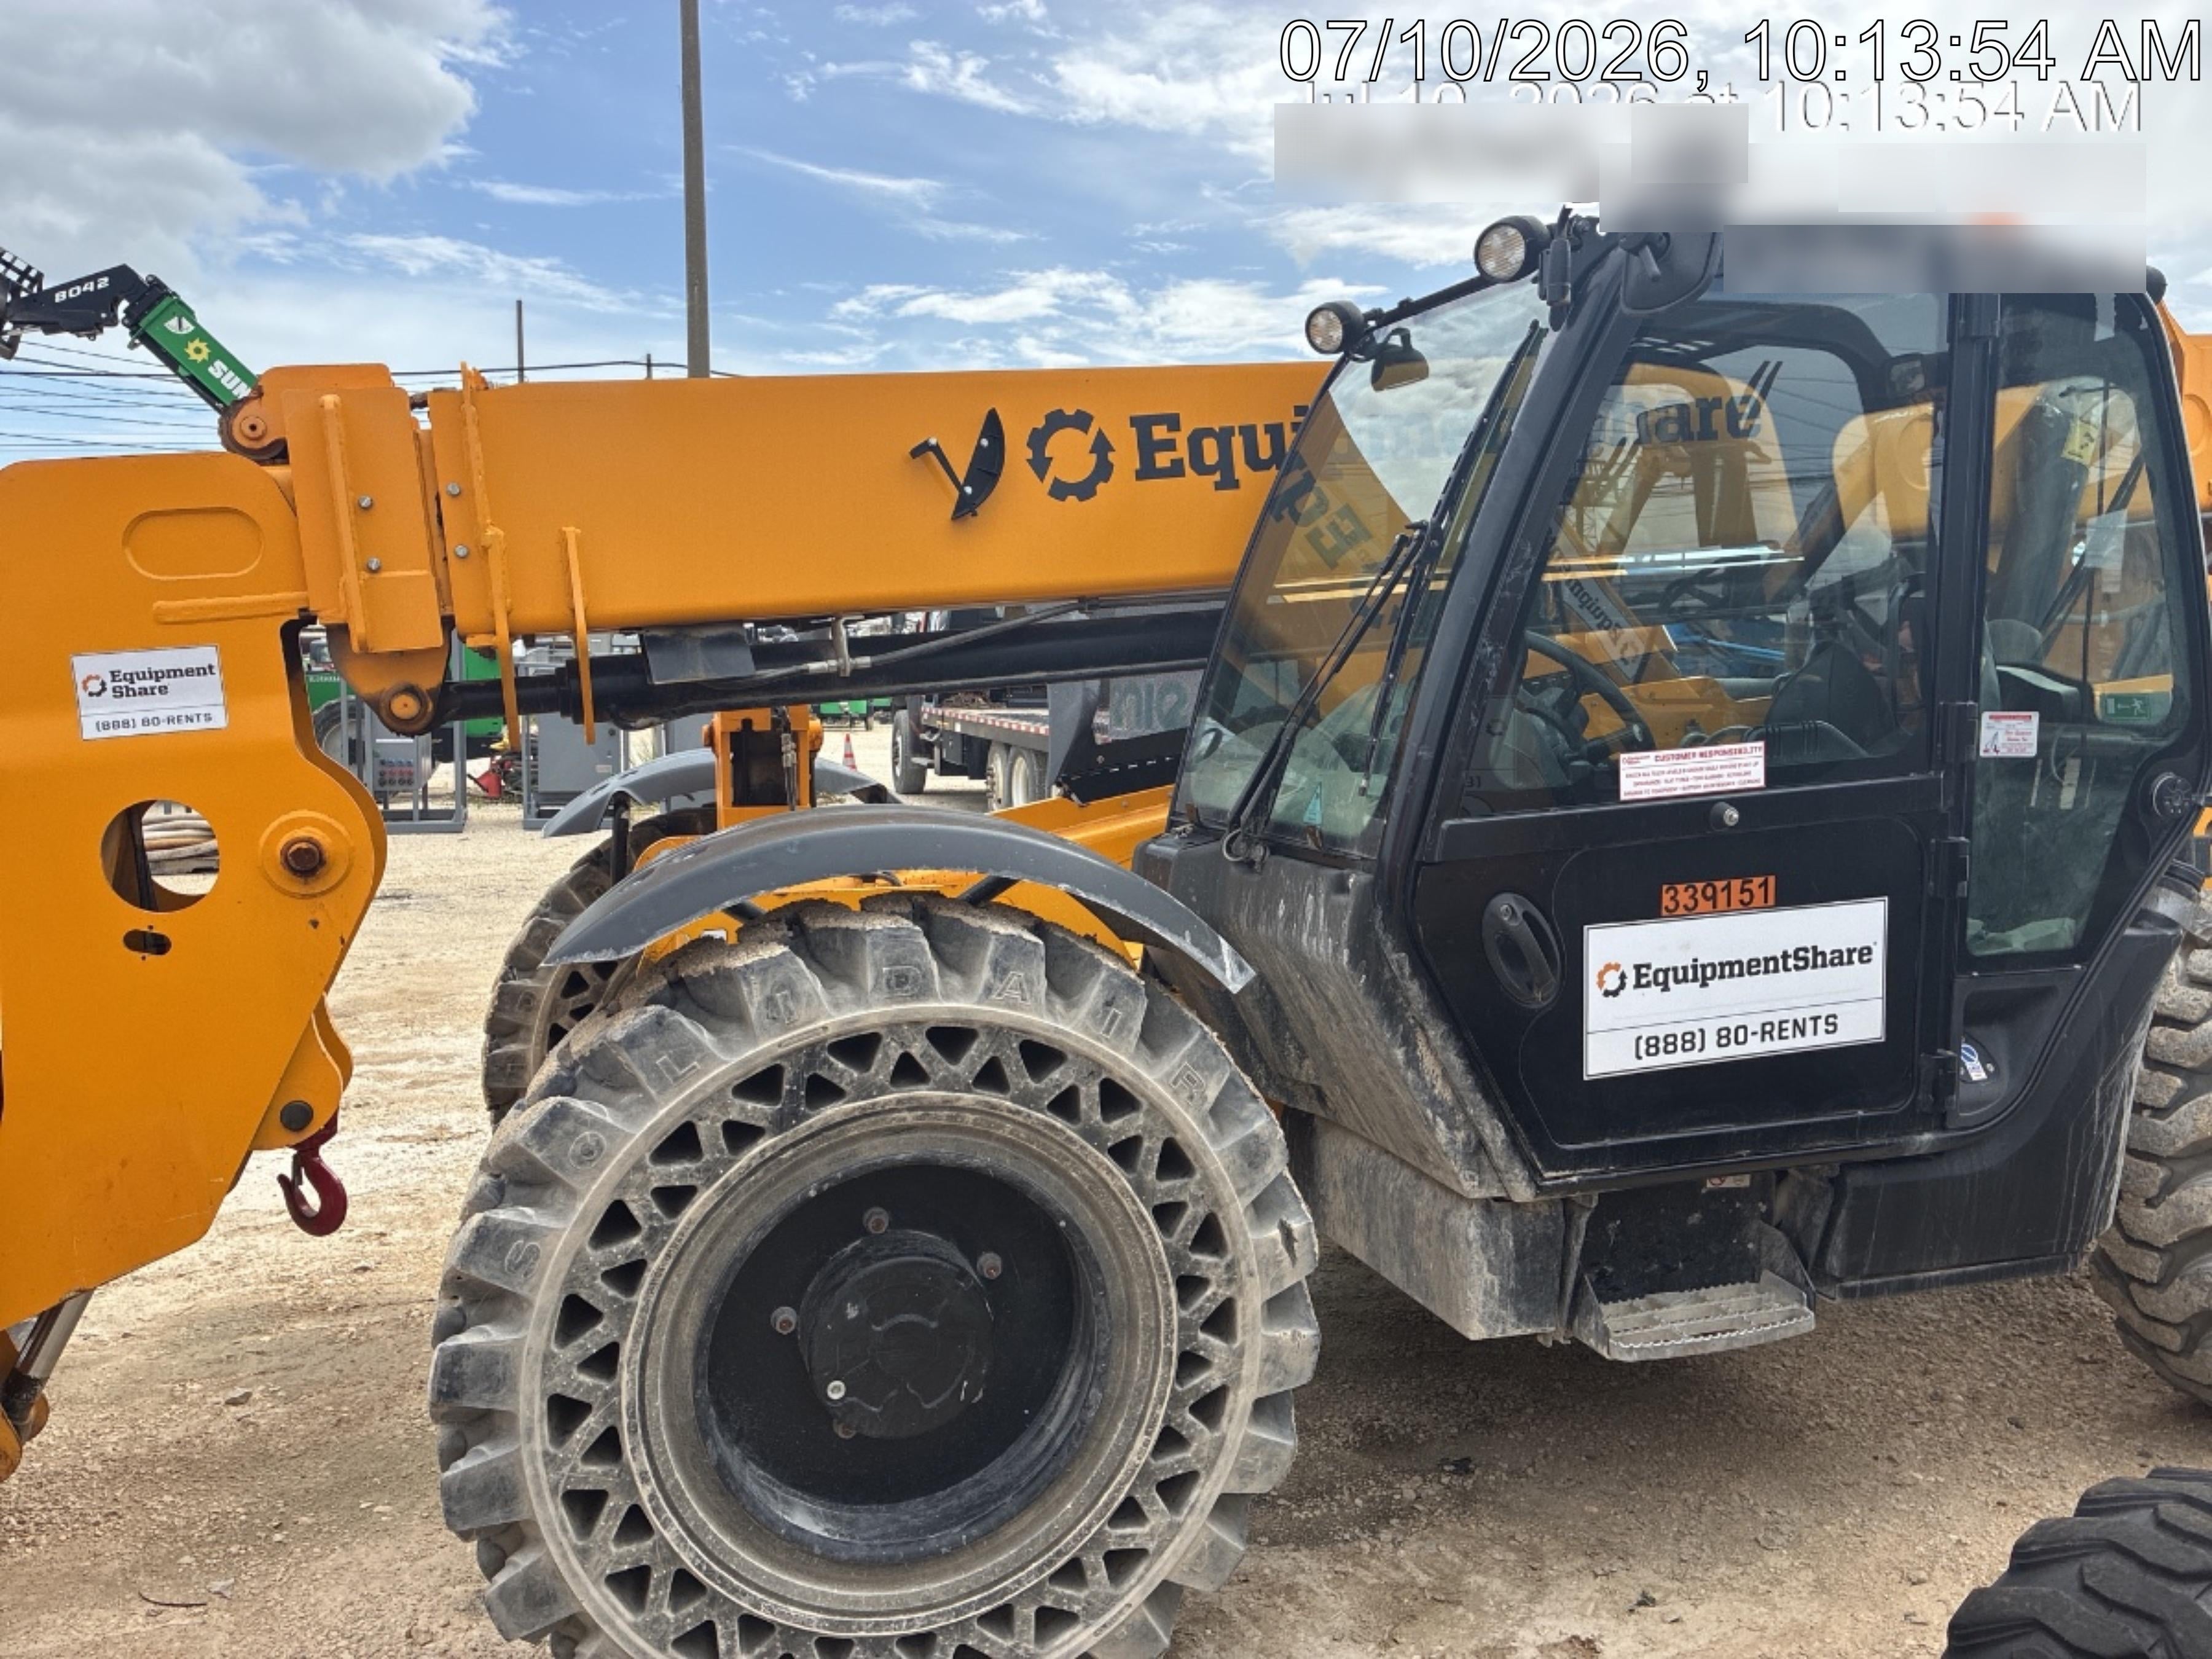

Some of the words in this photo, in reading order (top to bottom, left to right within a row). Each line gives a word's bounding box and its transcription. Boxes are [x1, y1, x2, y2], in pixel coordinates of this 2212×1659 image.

[54, 276, 109, 303] 8042
[109, 664, 216, 684] Equipment
[112, 685, 168, 699] Share
[96, 719, 136, 732] (888)
[142, 713, 212, 726] 80-RENTS
[1664, 877, 1771, 914] 339151
[1633, 945, 1873, 992] EquipmentShare
[1634, 1027, 1706, 1061] (888)
[1716, 1013, 1839, 1048] 80-RENTS
